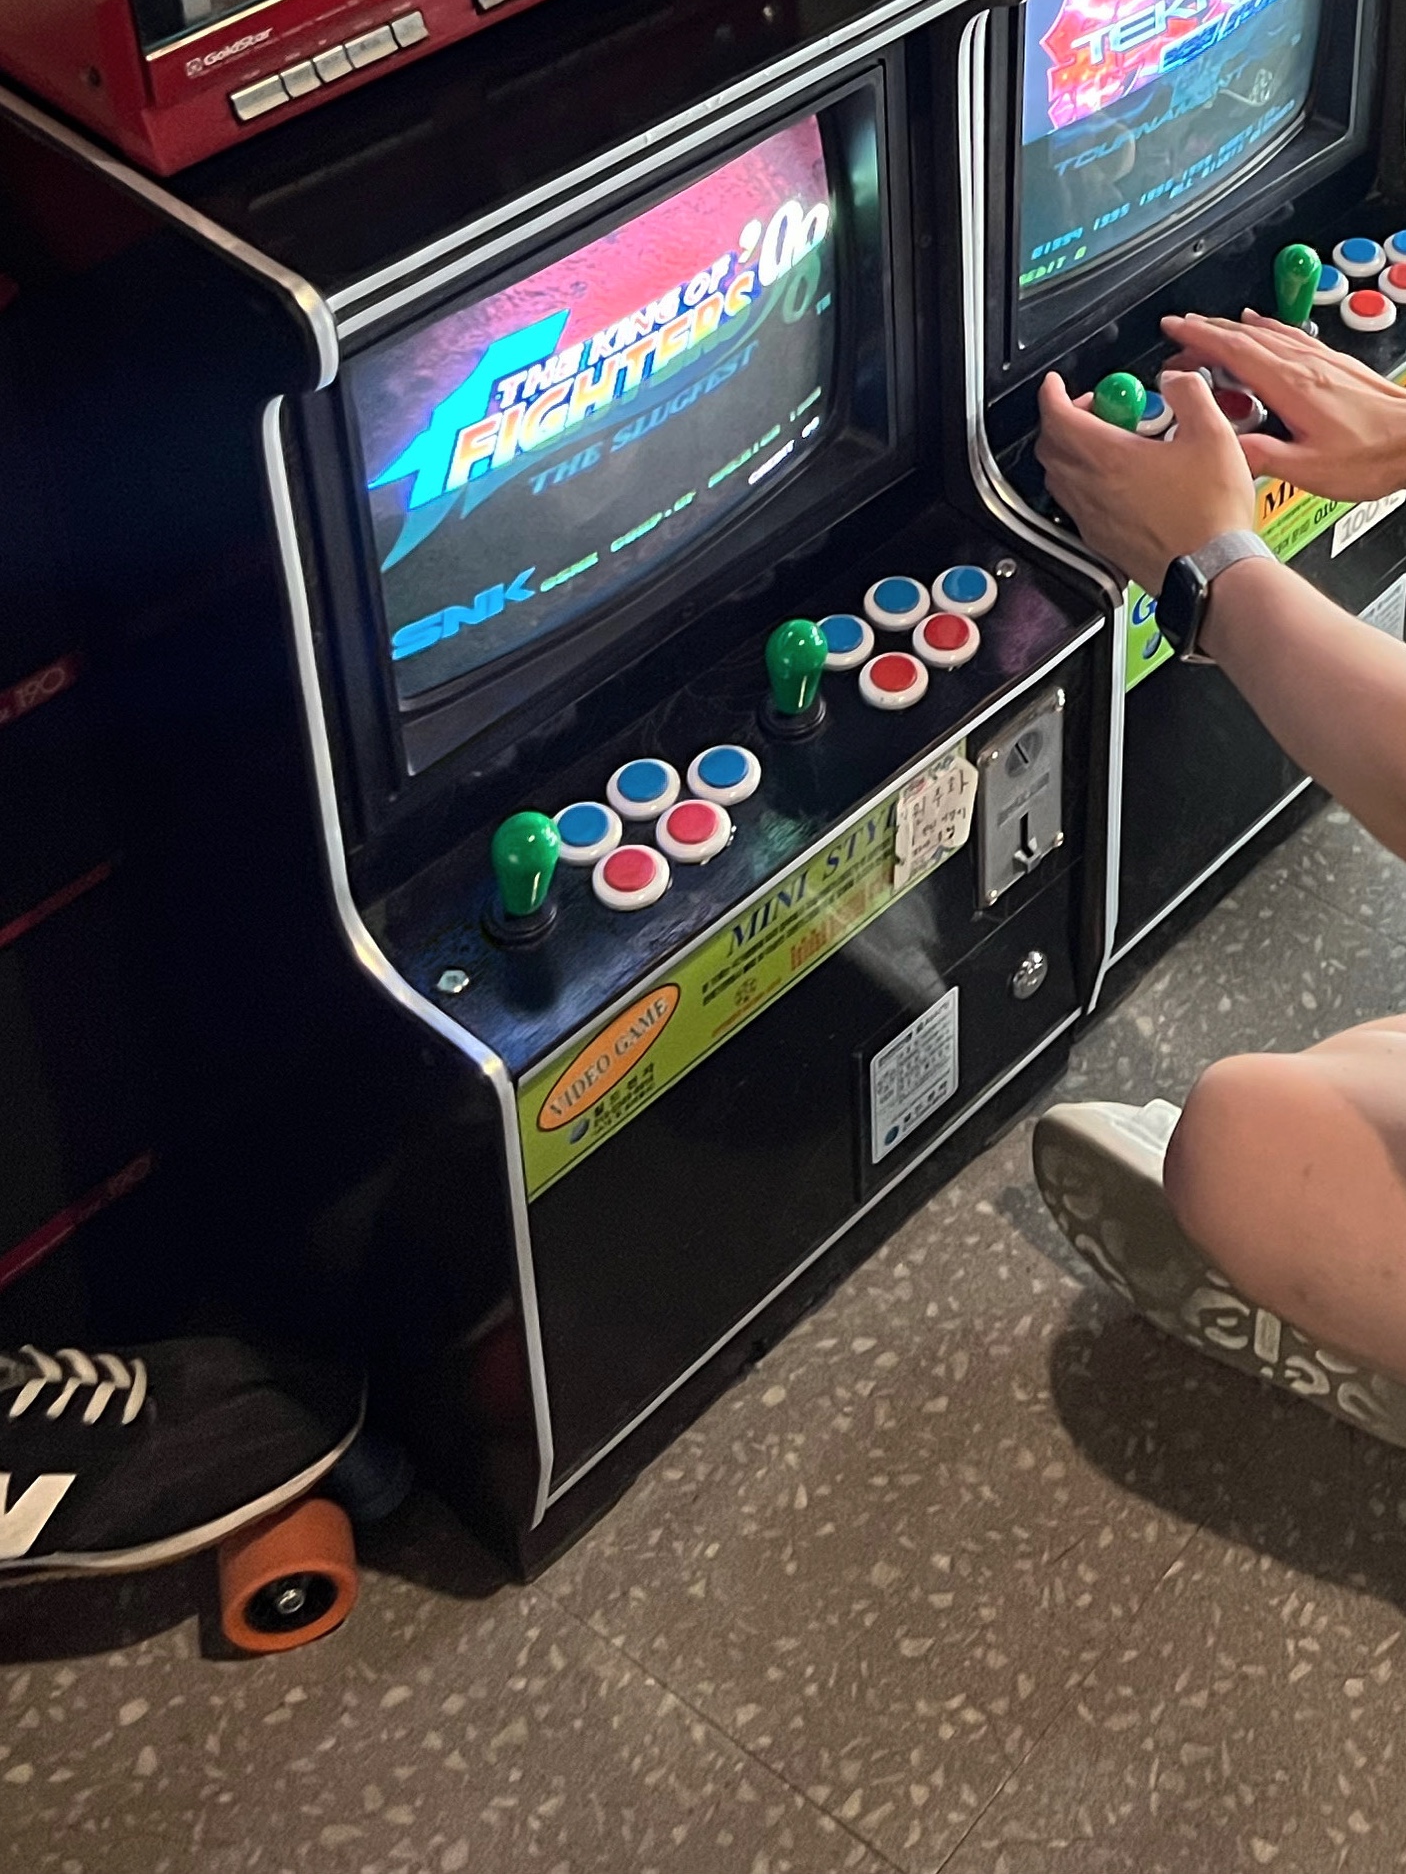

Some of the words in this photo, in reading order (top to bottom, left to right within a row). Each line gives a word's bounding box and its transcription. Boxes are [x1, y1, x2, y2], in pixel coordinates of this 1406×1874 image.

[204, 28, 273, 66] GoldStar
[443, 271, 756, 493] FIGHTERS
[496, 350, 580, 409] THE
[589, 287, 681, 365] KING
[684, 254, 732, 307] OF
[392, 567, 536, 660] SNK
[727, 870, 809, 958] MINI
[549, 1054, 611, 1116] VIDEO
[614, 997, 668, 1057] GAME
